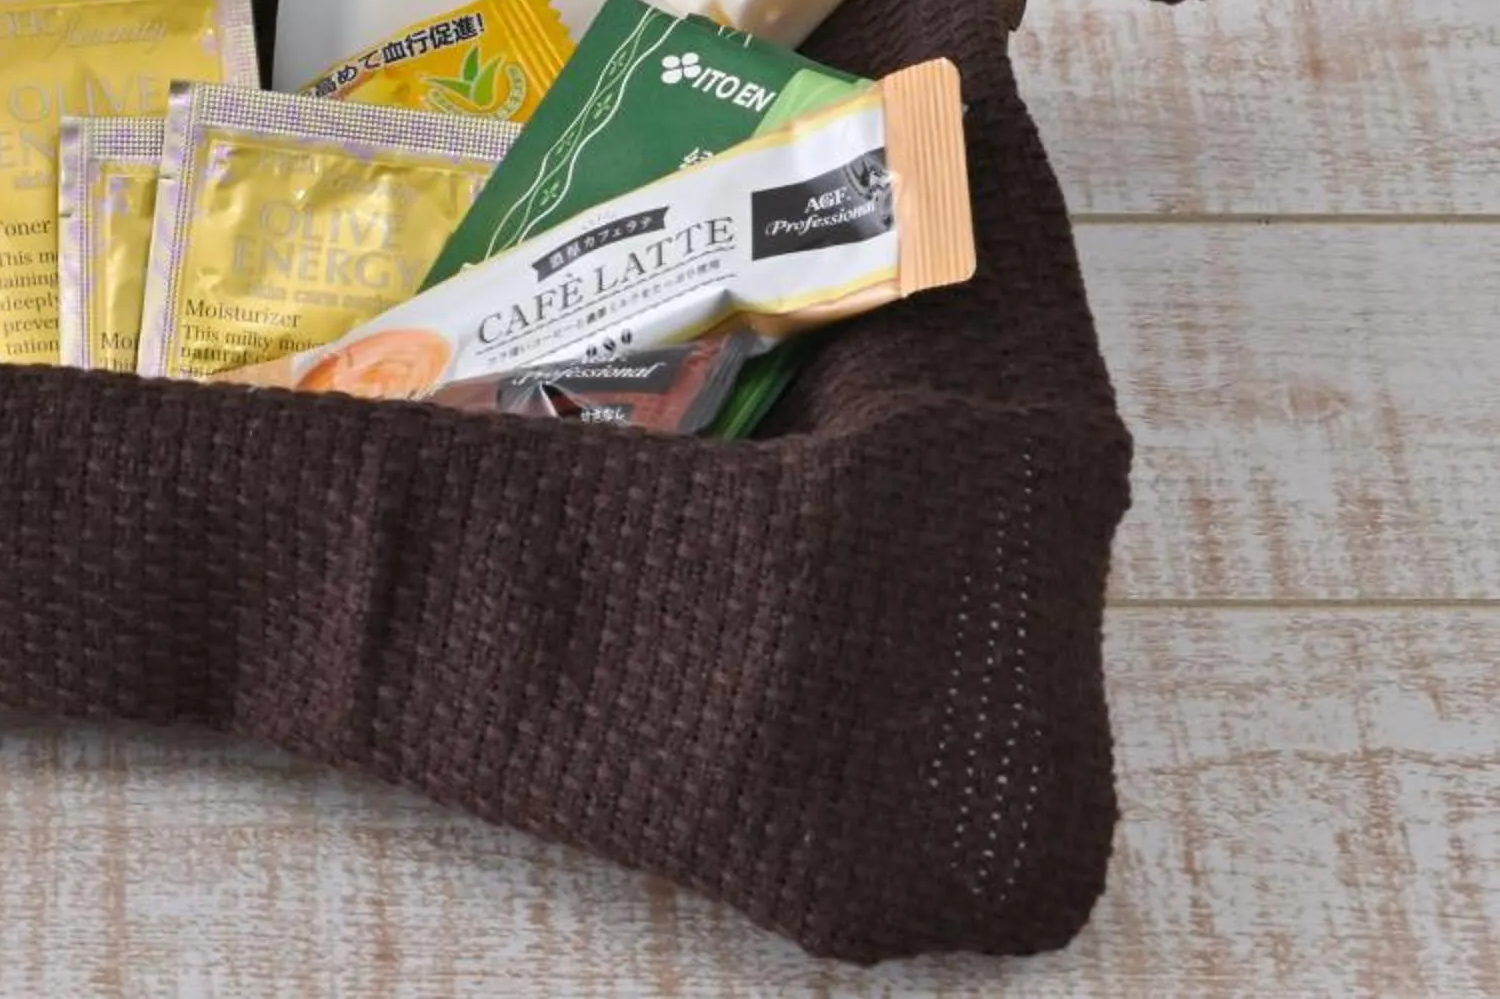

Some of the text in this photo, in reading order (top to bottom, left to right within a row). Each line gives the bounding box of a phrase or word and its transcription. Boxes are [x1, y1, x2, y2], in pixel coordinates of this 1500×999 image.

[258, 201, 403, 251] OLIVE
[233, 235, 423, 288] ENERGY
[594, 215, 735, 294] LATTE
[181, 324, 220, 344] This
[225, 331, 276, 352] milky
[184, 300, 302, 328] Moisturizer
